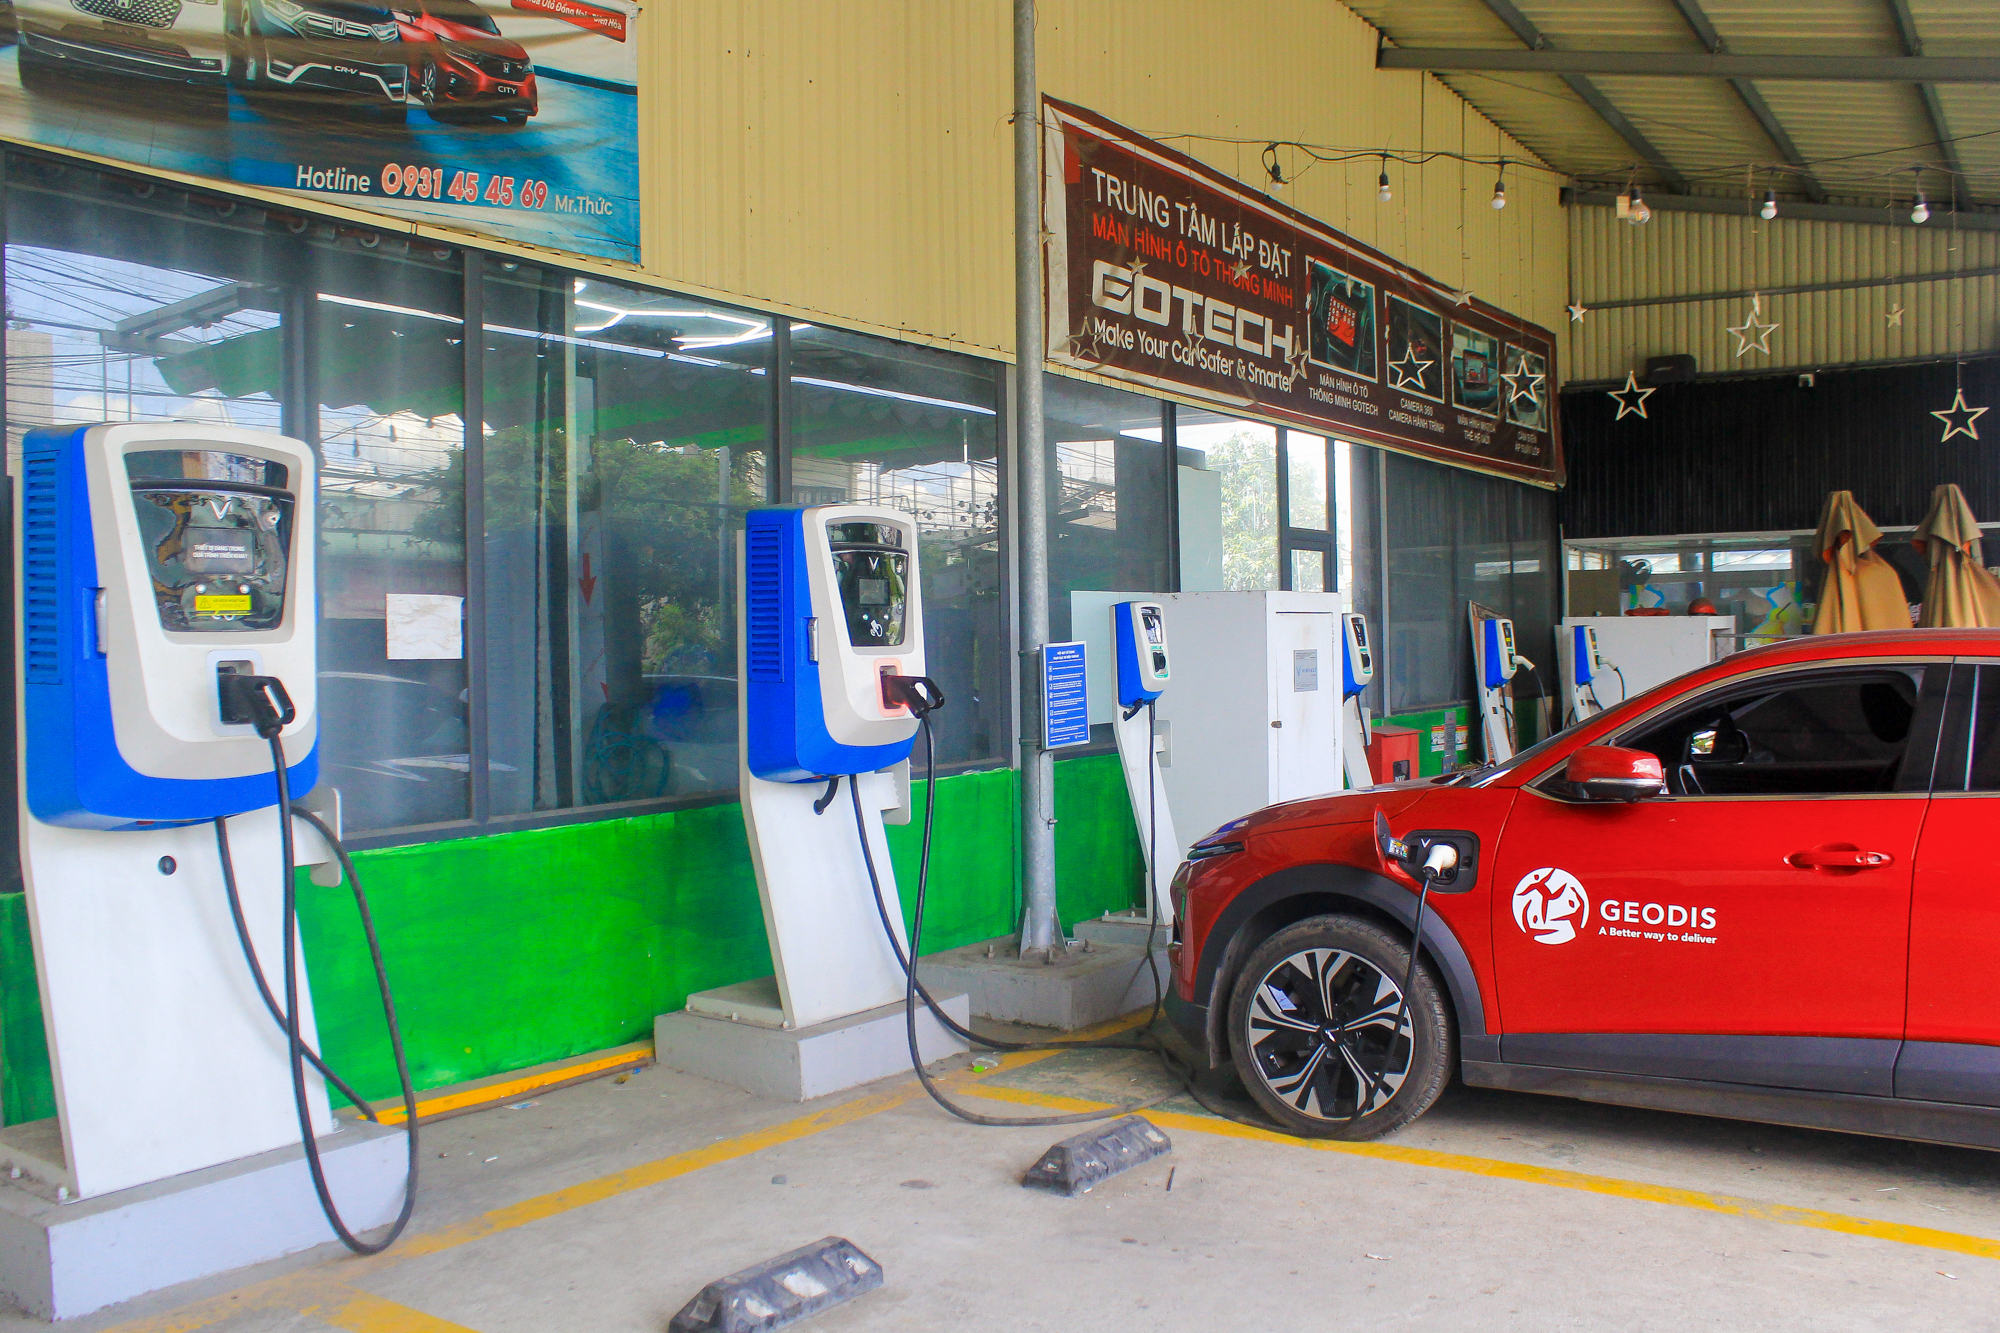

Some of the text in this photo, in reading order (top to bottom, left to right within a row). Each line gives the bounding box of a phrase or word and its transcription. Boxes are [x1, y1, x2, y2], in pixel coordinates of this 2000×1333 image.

[334, 65, 358, 76] CR-V
[497, 85, 518, 95] CITY
[296, 162, 613, 216] Hotline 0931 45 45 69 Mr.Thức
[1092, 167, 1170, 228] TRUNG
[1175, 202, 1216, 248] TÂM
[1259, 239, 1291, 278] ĐẶT
[1093, 213, 1129, 247] MÀN
[1135, 227, 1171, 263] HÌNH
[1176, 240, 1187, 267] Ô
[1191, 250, 1210, 276] TÔ
[1263, 278, 1293, 308] MINH
[1092, 259, 1293, 363] GOTECH
[1094, 317, 1293, 393] Make Your Car Safer & Smarter
[1309, 387, 1378, 416] THÔNG MINH GOTECH
[1400, 397, 1423, 414] CAMERA
[1389, 409, 1412, 425] CAMERA
[1600, 899, 1717, 930] GEODIS
[1598, 927, 1717, 944] A Better way to deliver
